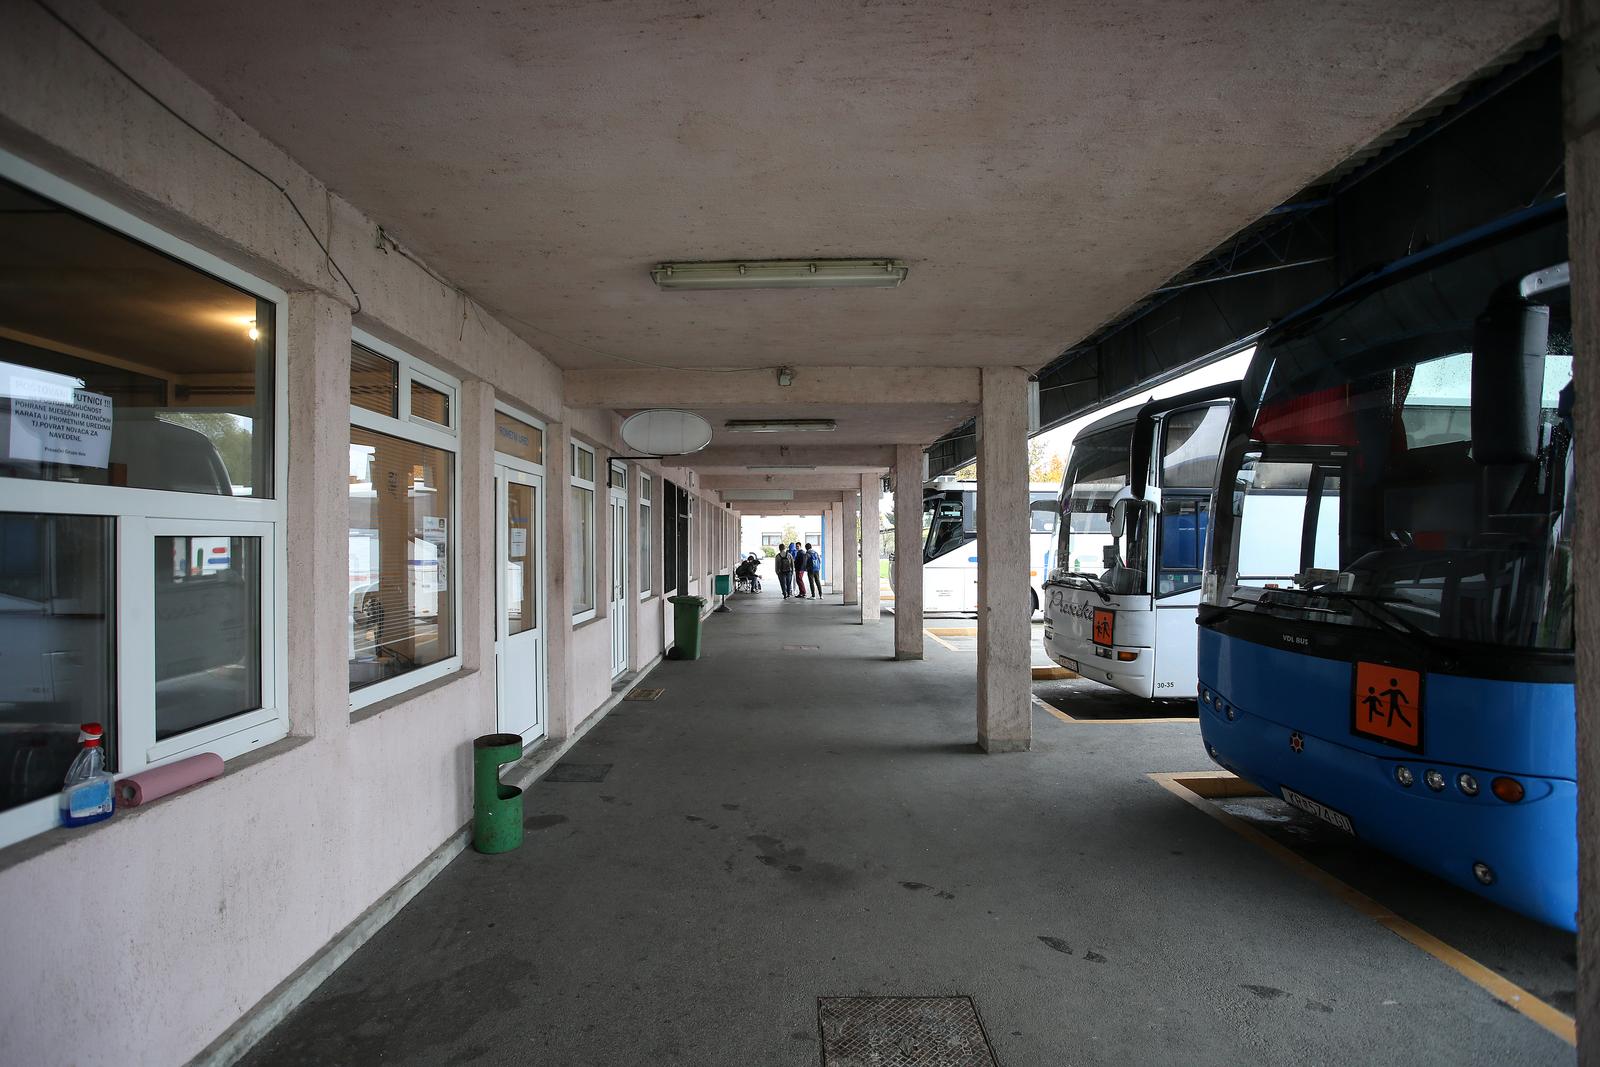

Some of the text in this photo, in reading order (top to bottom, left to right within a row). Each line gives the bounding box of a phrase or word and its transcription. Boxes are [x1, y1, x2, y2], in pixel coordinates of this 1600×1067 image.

[15, 401, 46, 412] POHRANE
[14, 409, 42, 420] KARATA
[49, 414, 85, 427] PROMETNIM
[66, 425, 89, 436] NOVACA
[90, 429, 98, 438] ZA
[1282, 633, 1309, 646] VDL BUS
[1157, 681, 1175, 689] 30-35
